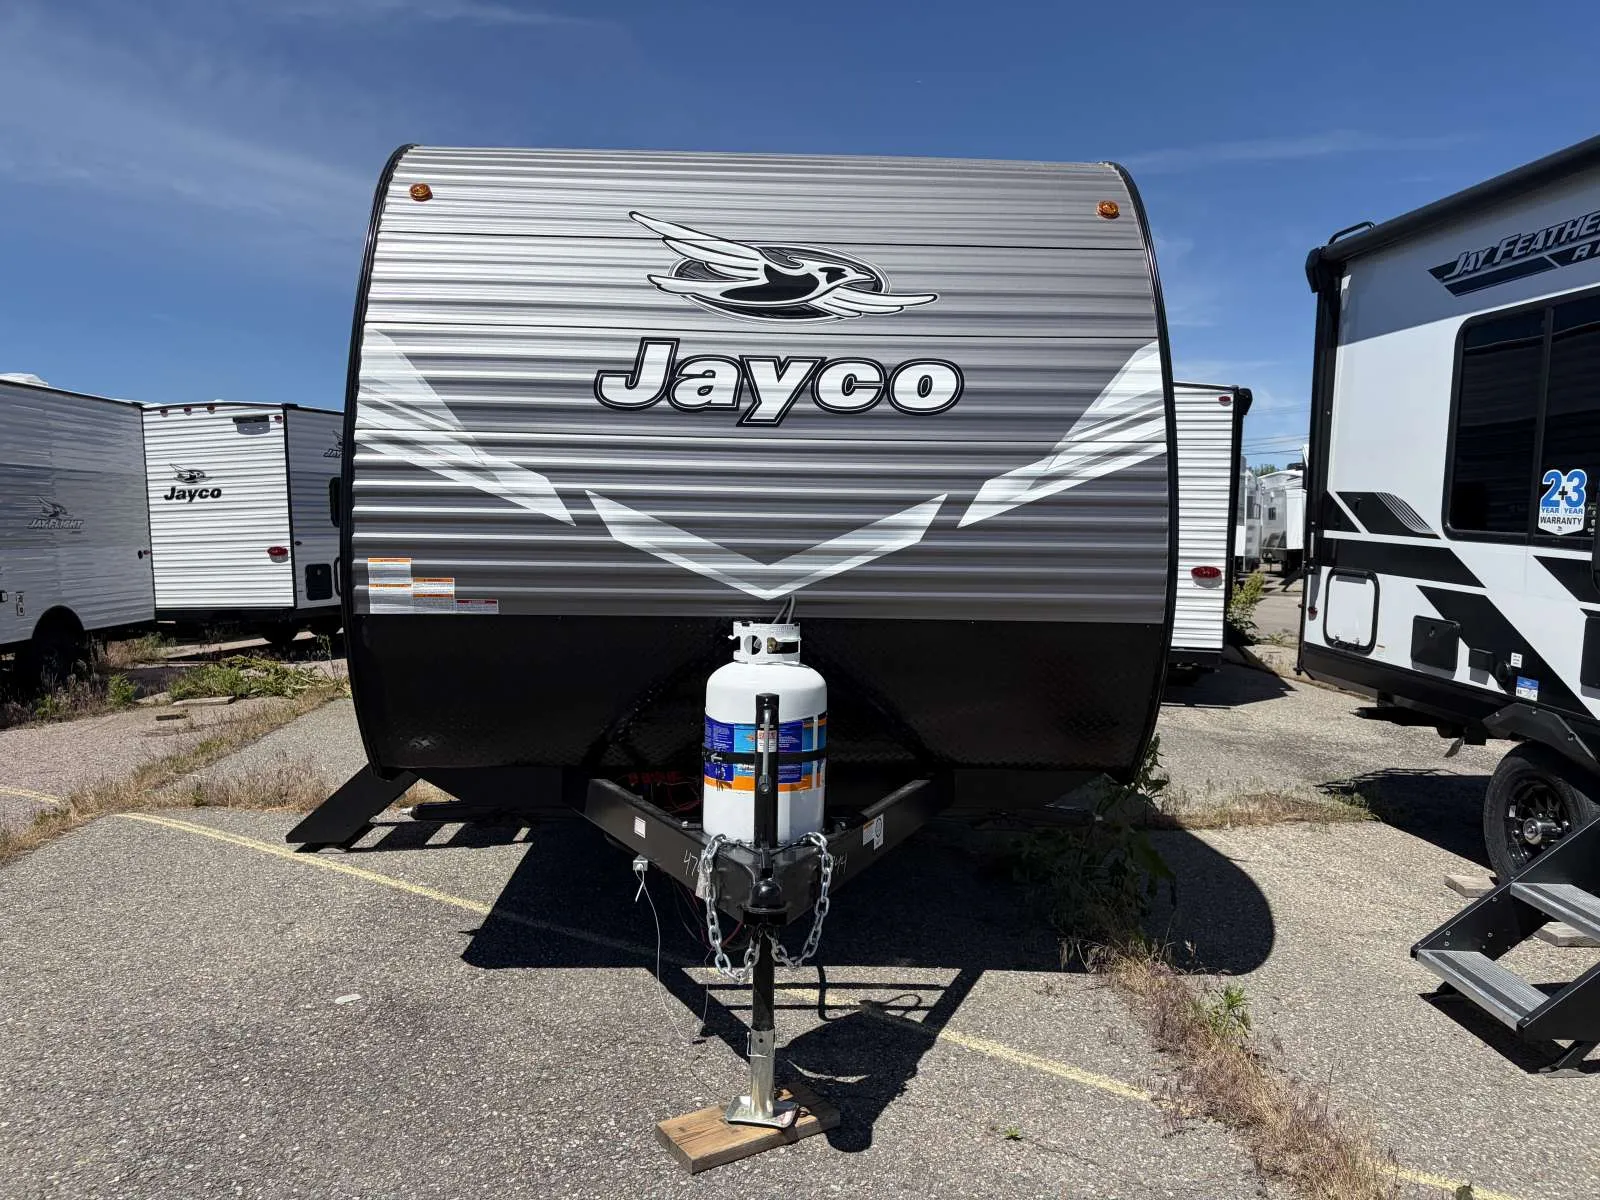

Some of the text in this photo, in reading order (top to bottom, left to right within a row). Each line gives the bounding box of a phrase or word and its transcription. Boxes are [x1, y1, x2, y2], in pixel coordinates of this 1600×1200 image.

[1442, 250, 1494, 281] JAY
[594, 337, 965, 428] Jayco
[163, 486, 222, 504] Jayco
[1564, 507, 1584, 515] YEAR
[48, 519, 83, 530] FLIGHT
[1540, 516, 1583, 525] WARRANTY
